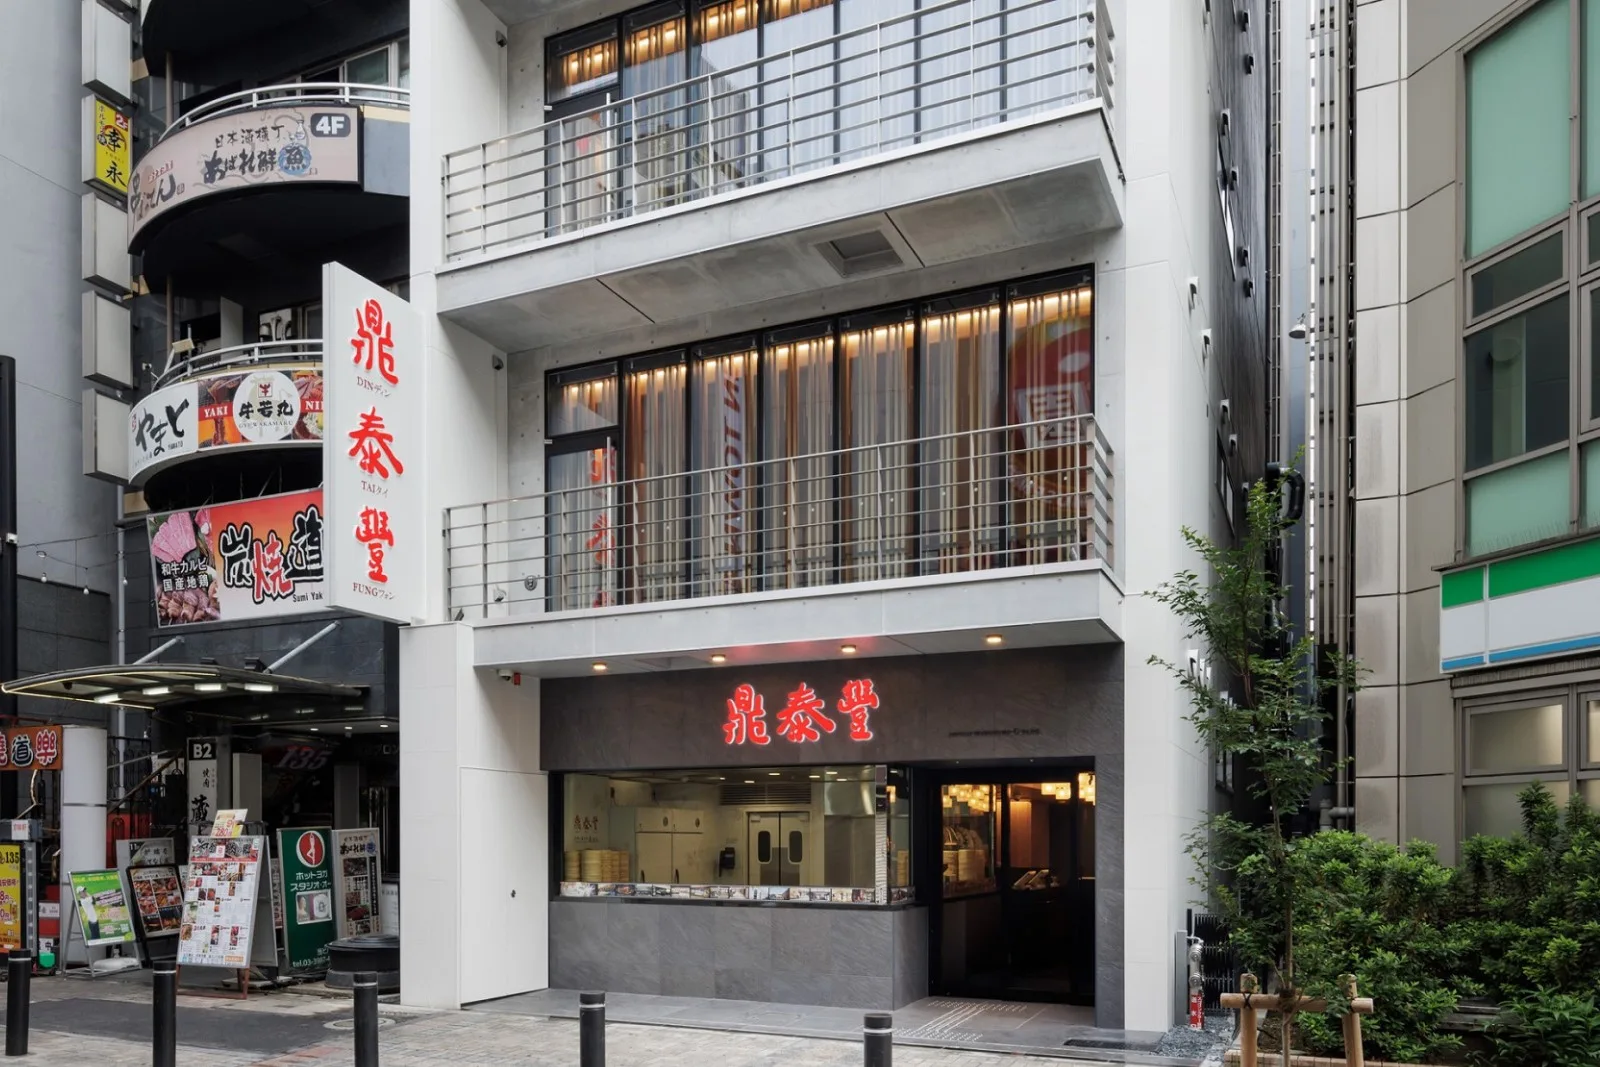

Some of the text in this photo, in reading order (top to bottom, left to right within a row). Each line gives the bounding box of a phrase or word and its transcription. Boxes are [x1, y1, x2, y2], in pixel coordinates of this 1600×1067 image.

[316, 116, 345, 135] 4F
[215, 125, 285, 148] 日本酒横丁
[104, 128, 127, 188] 幸永
[204, 406, 228, 418] YAKI
[239, 400, 294, 419] 牛若丸
[305, 401, 323, 411] NI
[135, 398, 189, 456] やまと
[161, 558, 207, 576] 和牛カルビ
[163, 575, 209, 592] 国産地鶏
[292, 593, 309, 603] Sumi
[193, 743, 212, 758] B2
[296, 869, 328, 881] ホットヨガ
